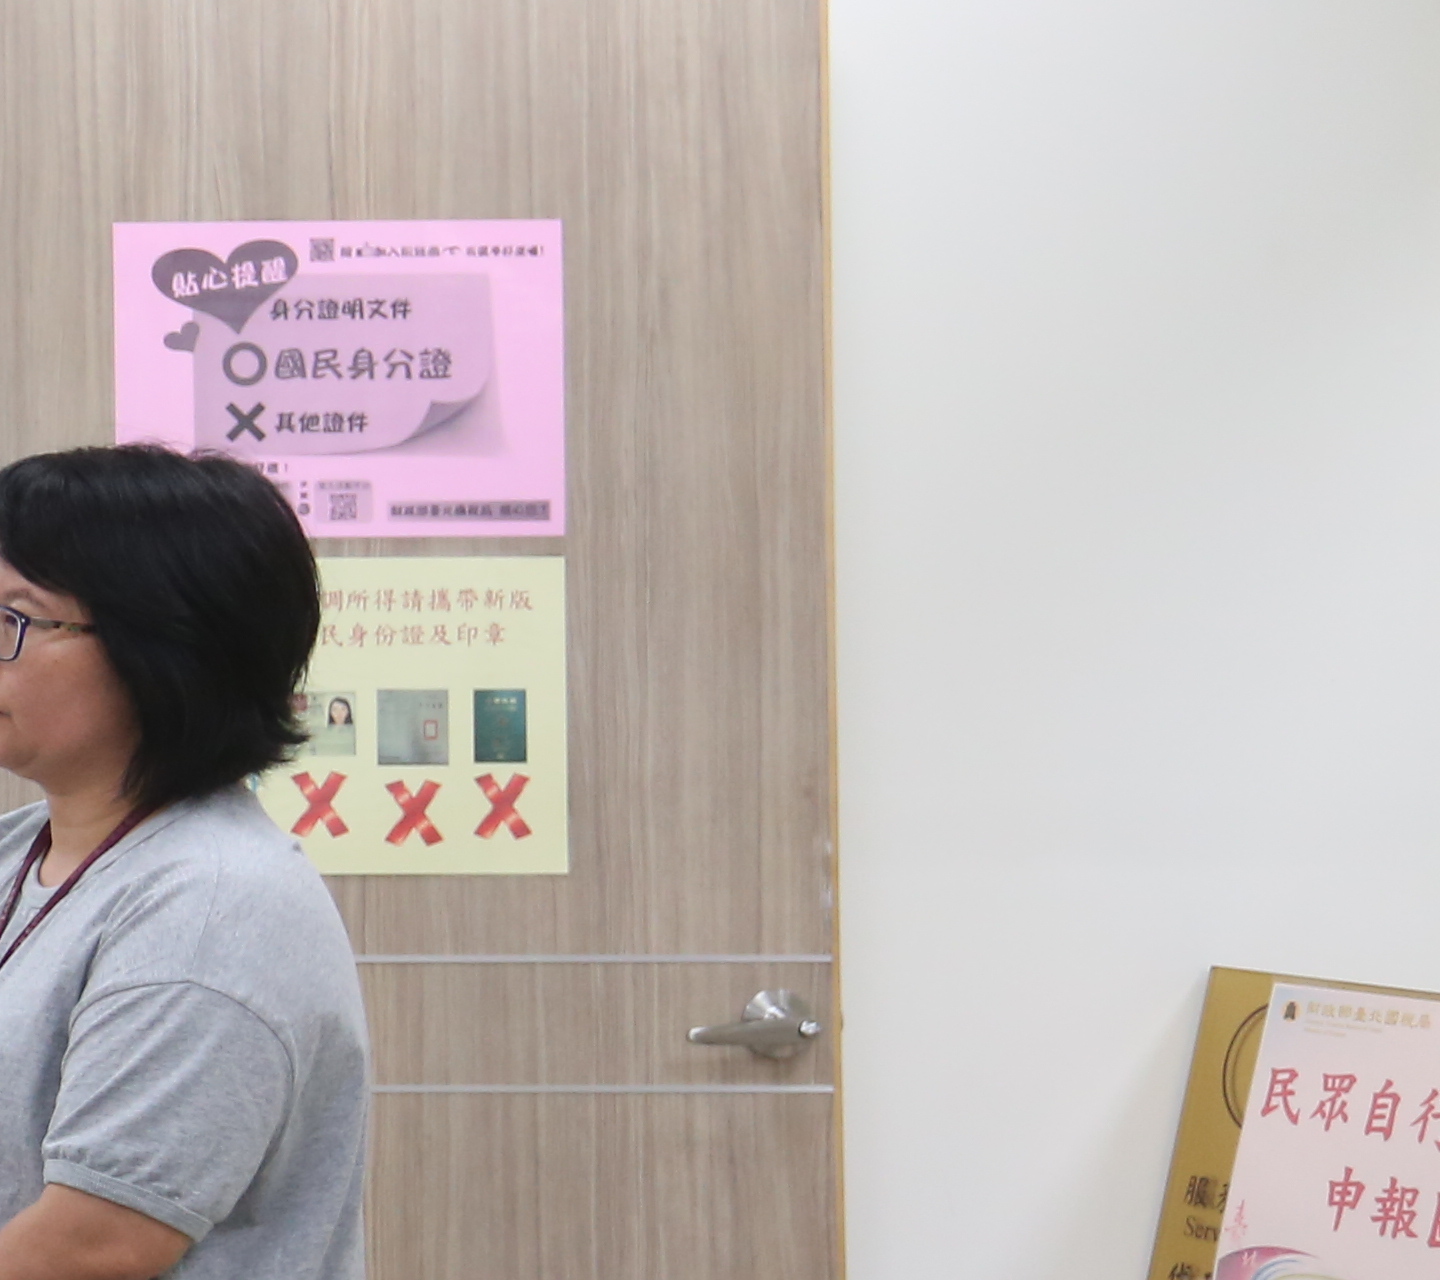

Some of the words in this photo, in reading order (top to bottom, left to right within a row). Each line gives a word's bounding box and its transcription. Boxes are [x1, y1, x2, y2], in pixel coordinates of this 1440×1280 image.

[171, 256, 288, 299] 貼心提醒
[270, 298, 413, 321] 身分證明文件
[275, 348, 453, 380] 國民身分證
[276, 411, 369, 434] 其他證件
